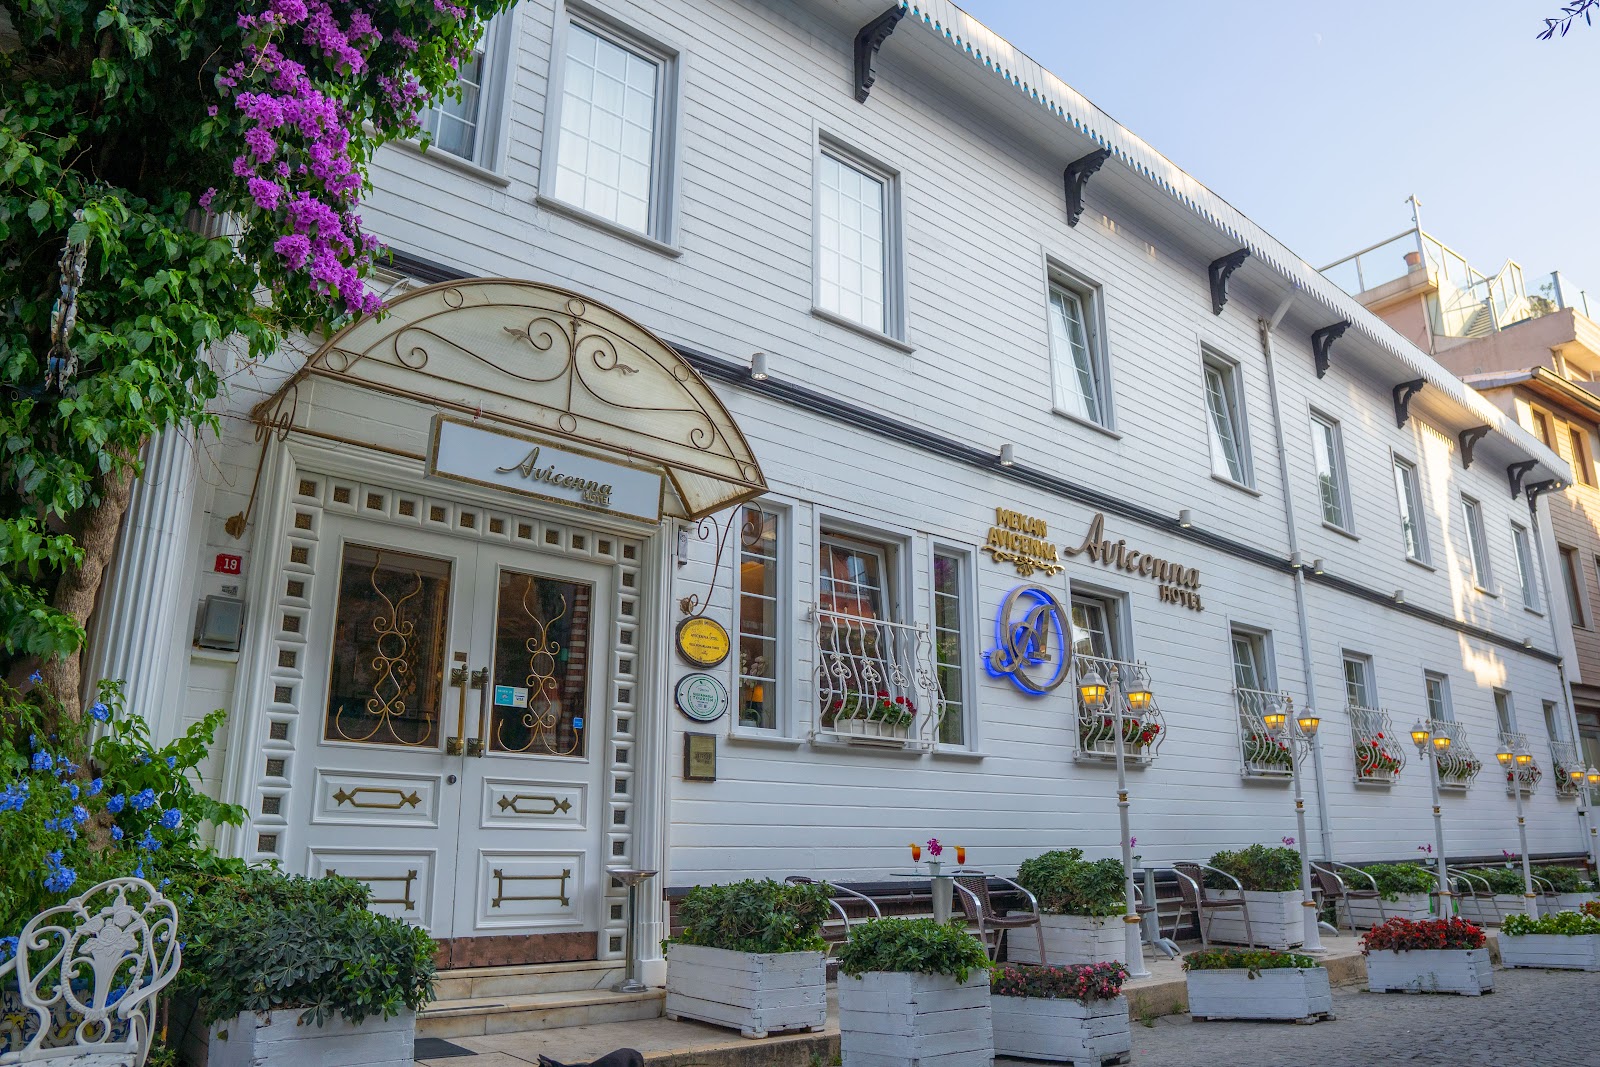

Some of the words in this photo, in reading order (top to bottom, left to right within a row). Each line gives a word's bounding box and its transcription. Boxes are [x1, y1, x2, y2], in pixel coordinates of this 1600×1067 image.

[496, 447, 612, 495] Avicenna
[583, 491, 612, 506] HOTEL
[996, 507, 1048, 538] MEKAN
[987, 527, 1060, 562] AVICENNA
[1064, 512, 1202, 589] Avicenna
[223, 558, 238, 570] 19
[1159, 584, 1204, 612] HOTEL
